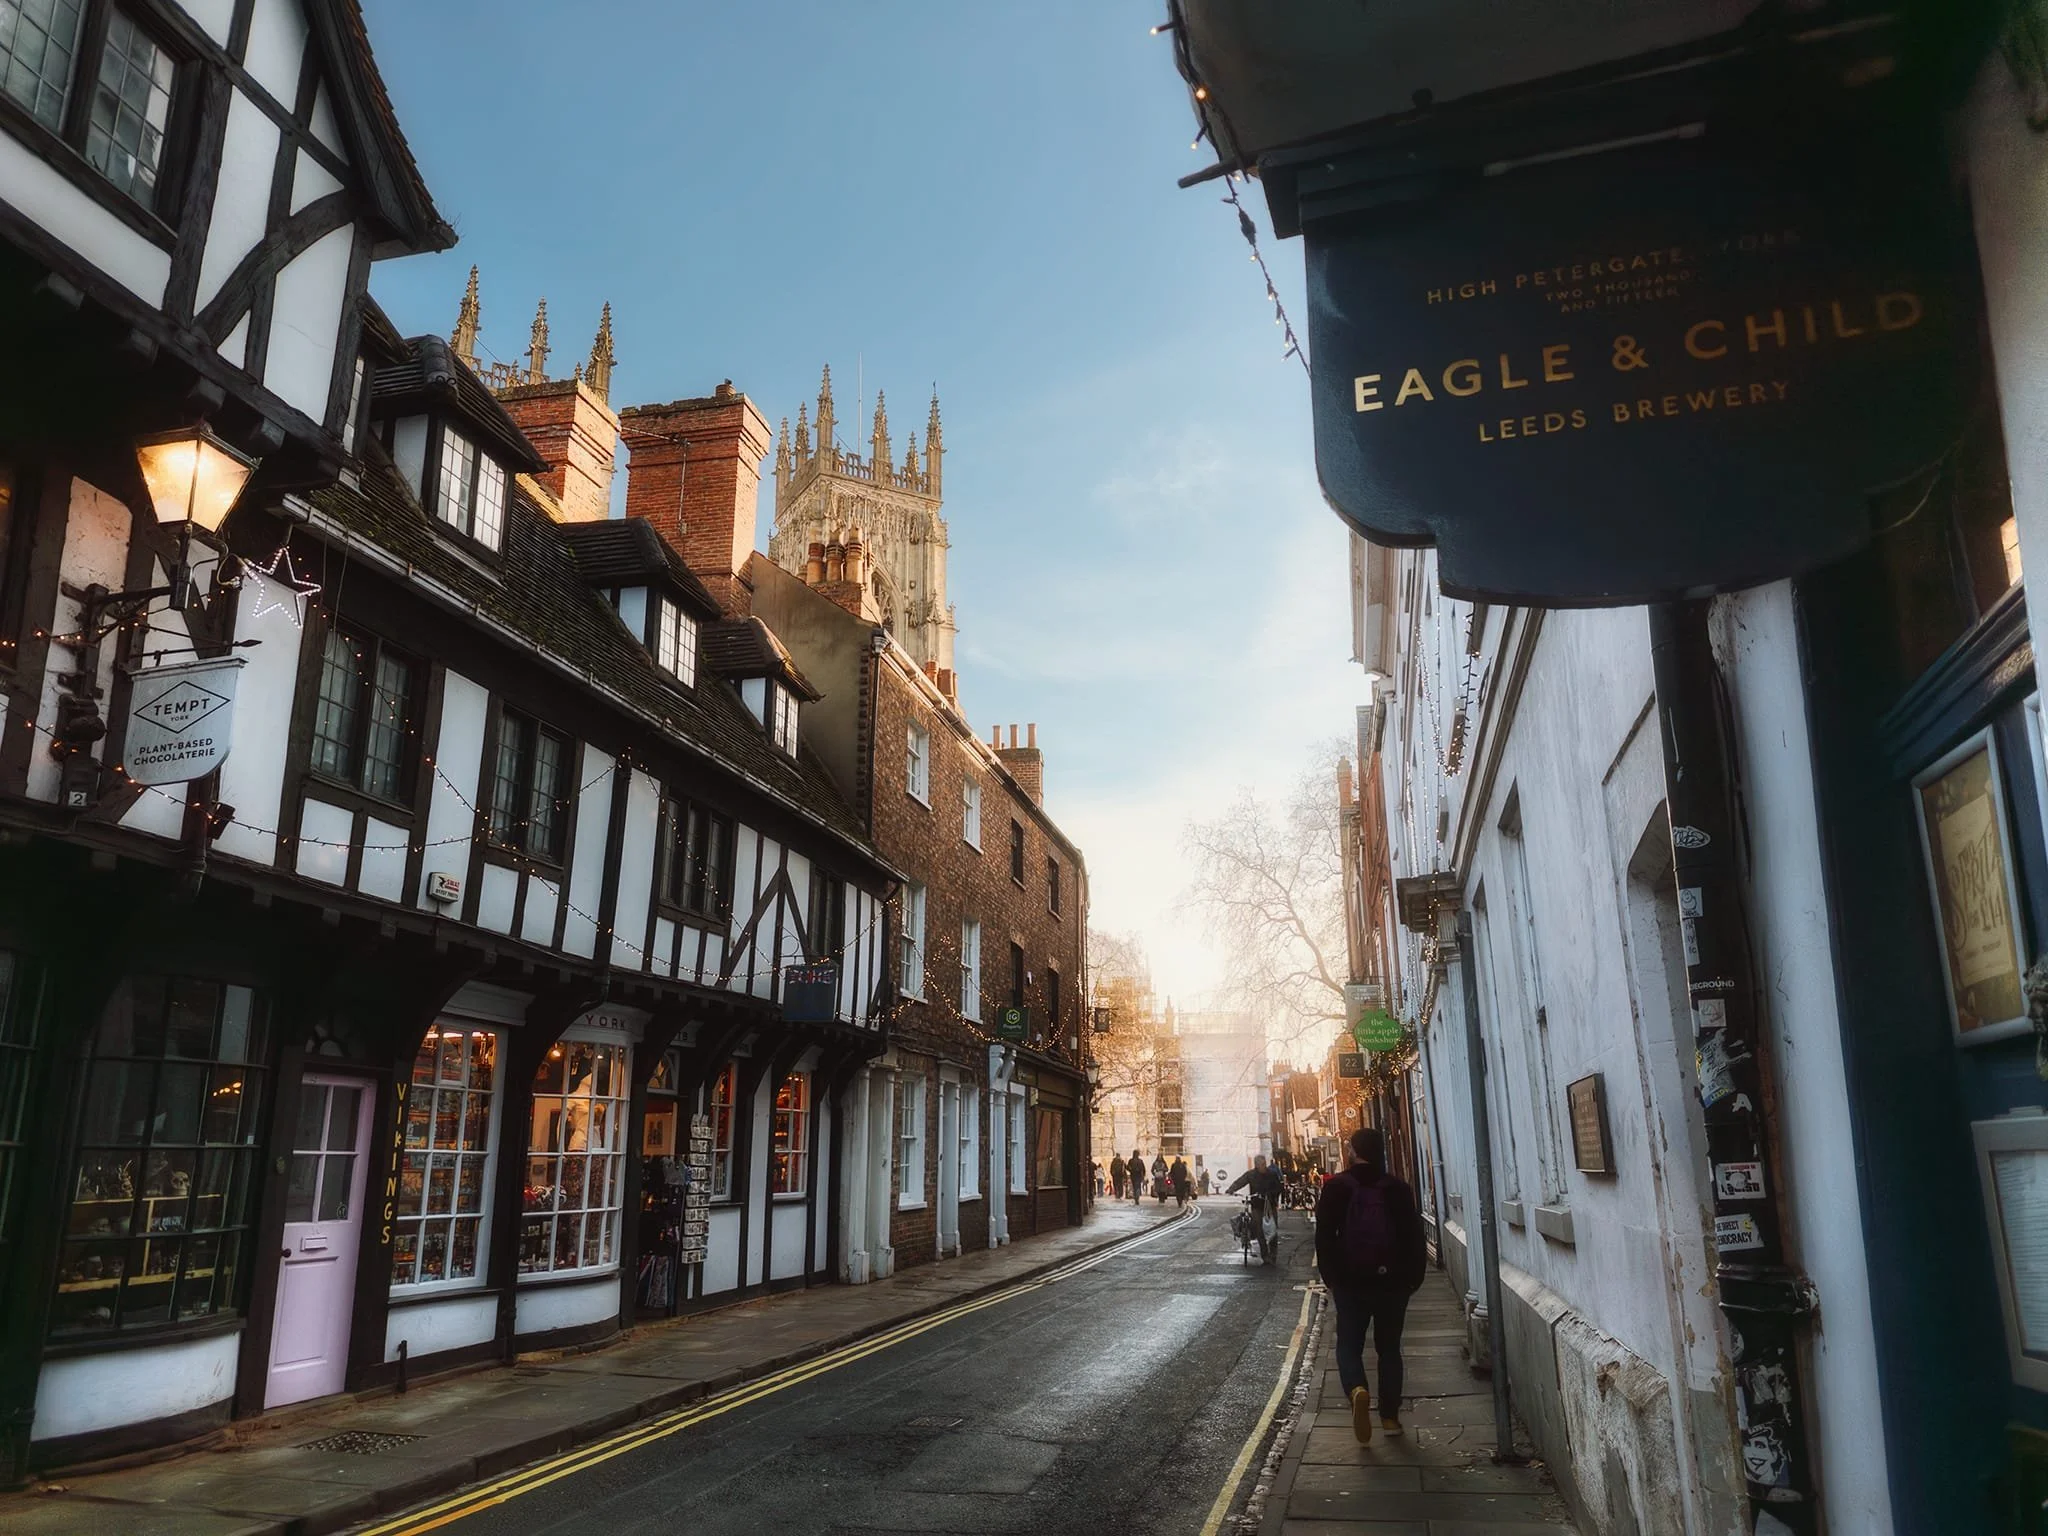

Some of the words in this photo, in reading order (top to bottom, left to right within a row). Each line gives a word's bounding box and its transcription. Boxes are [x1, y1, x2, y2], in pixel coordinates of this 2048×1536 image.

[1426, 279, 1497, 305] HIGH
[1544, 286, 1584, 303] TWO
[1560, 299, 1596, 314] AND
[1353, 343, 1575, 413] EAGLE
[1611, 334, 1650, 372] &
[1683, 290, 1926, 360] CHILD
[1478, 409, 1588, 443] LEEDS
[1612, 378, 1791, 423] BREWERY
[154, 698, 211, 717] TEMPT
[170, 714, 190, 722] YORK
[139, 737, 214, 756] PLANT-BASED
[133, 747, 216, 766] CHOCOLATERIE
[73, 793, 83, 805] 2
[585, 1014, 625, 1029] YORK
[1370, 1018, 1383, 1026] the
[1377, 1026, 1399, 1036] apple
[1345, 1058, 1358, 1067] 22
[381, 1082, 408, 1245] VIKINGS
